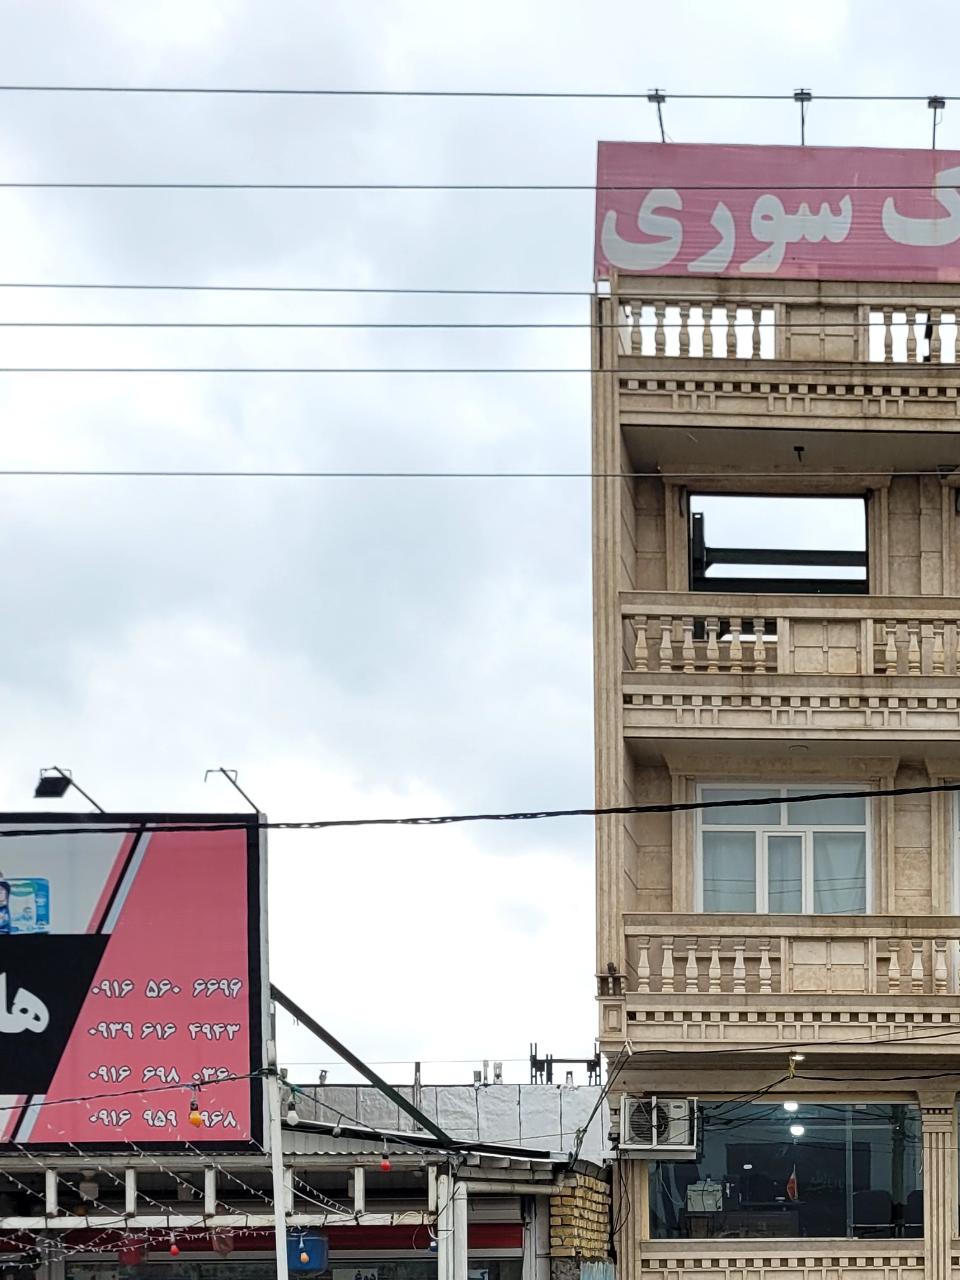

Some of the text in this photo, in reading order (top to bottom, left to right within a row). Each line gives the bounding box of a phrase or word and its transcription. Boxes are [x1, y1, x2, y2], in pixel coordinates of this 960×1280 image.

[601, 188, 852, 272] سوری
[91, 979, 134, 998] ۰۹۱۶
[145, 979, 181, 998] ۵۶۰
[88, 1022, 240, 1040] ۰۹۳۹ ۶۱۶ ۴۹۴۳
[89, 1065, 131, 1082] ۰۹۱۶
[142, 1066, 180, 1083] ۶۹۸
[89, 1109, 238, 1128] ۰۹۱۶ ۹۵۹ ۹۶۸
